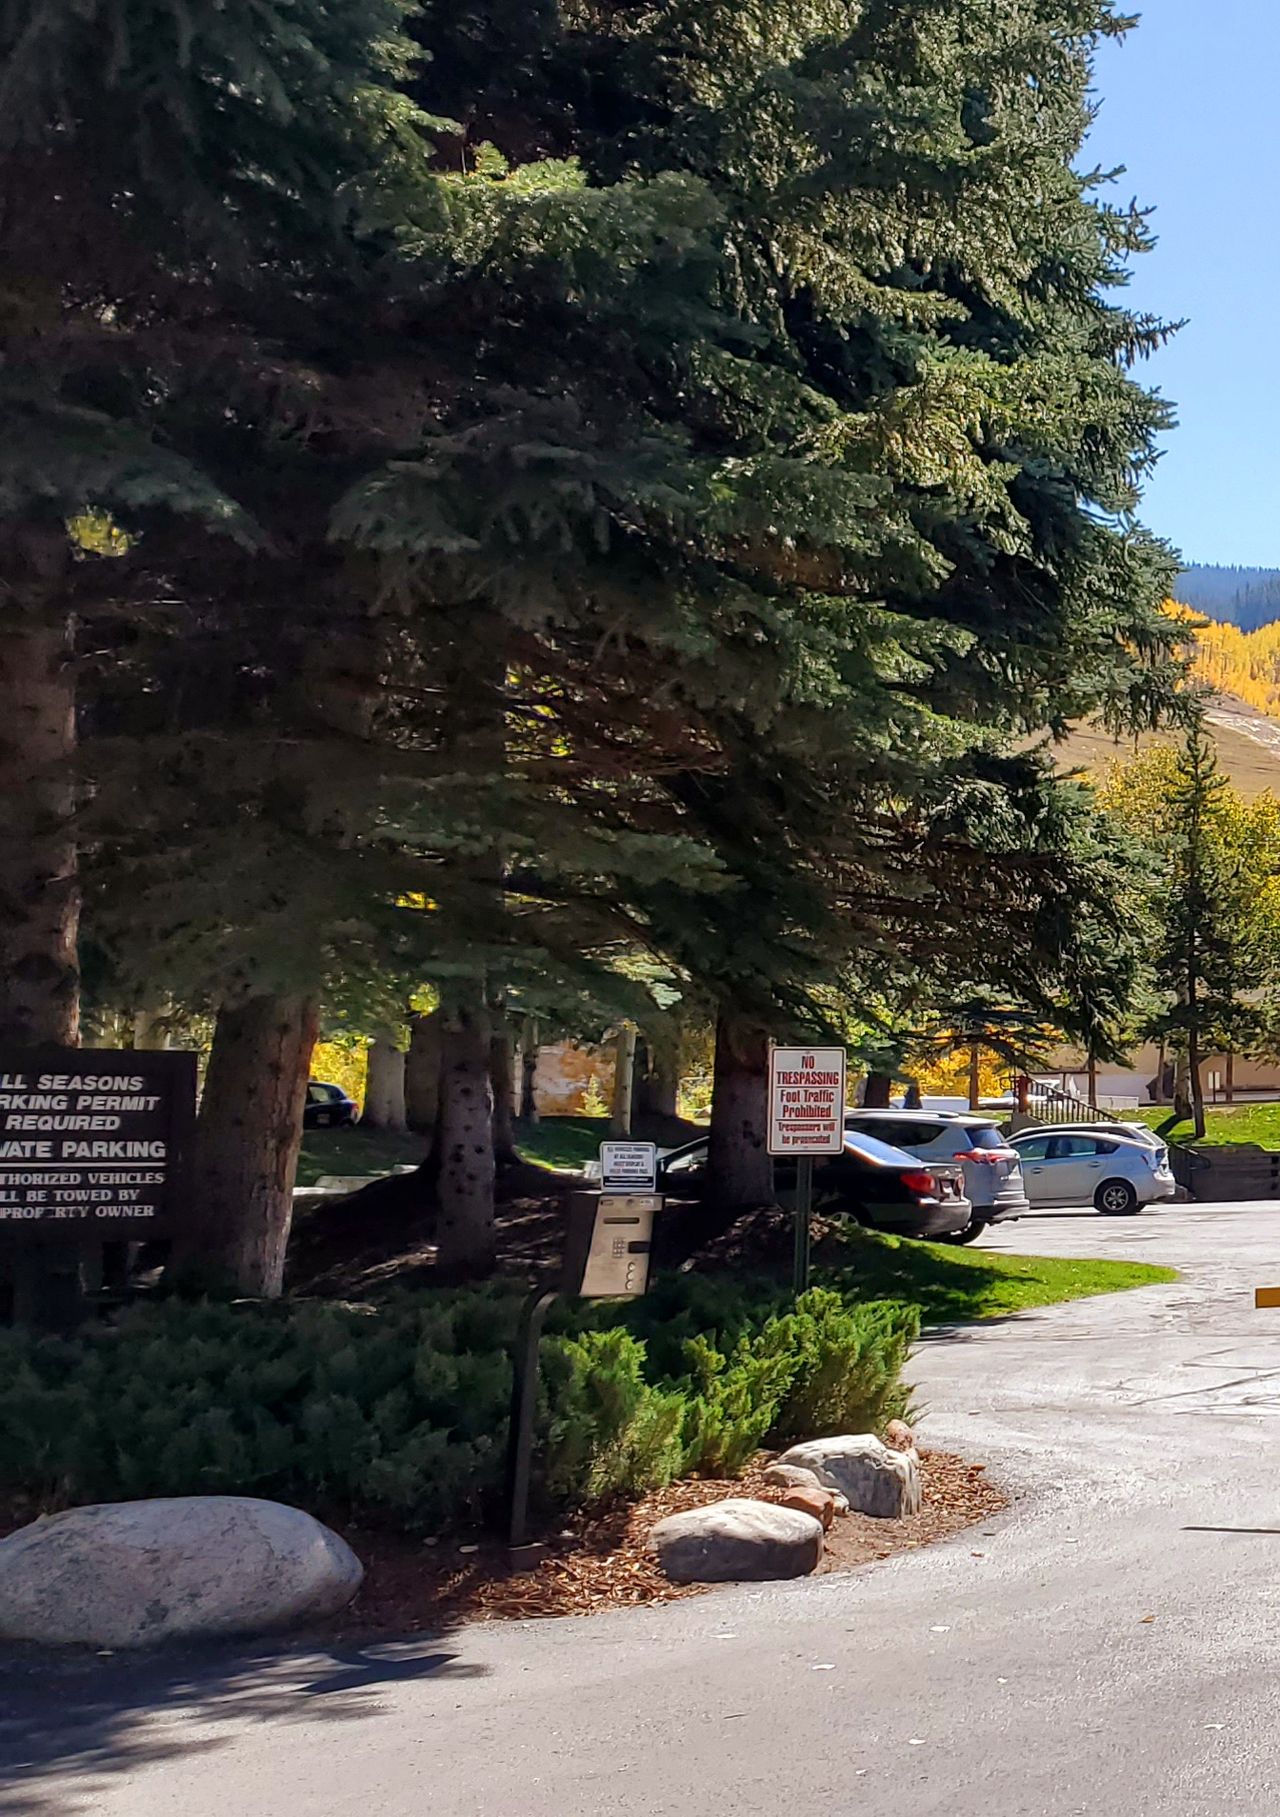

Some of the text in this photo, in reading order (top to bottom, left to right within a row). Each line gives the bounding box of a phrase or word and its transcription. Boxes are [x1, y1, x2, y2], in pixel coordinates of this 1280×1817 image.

[801, 1056, 815, 1069] NO
[0, 1074, 144, 1091] LL SEASONS
[776, 1071, 839, 1085] TRESPASSING
[803, 1089, 835, 1102] Traffic
[76, 1096, 161, 1111] PERMIT
[782, 1105, 832, 1118] Prohibited
[5, 1115, 120, 1130] REQUIRED
[62, 1141, 166, 1158] PARKING
[88, 1172, 165, 1184] VEHICLES
[26, 1190, 47, 1202] BE
[53, 1190, 112, 1202] TOWED
[118, 1189, 140, 1201] BY
[95, 1205, 155, 1217] OWNER
